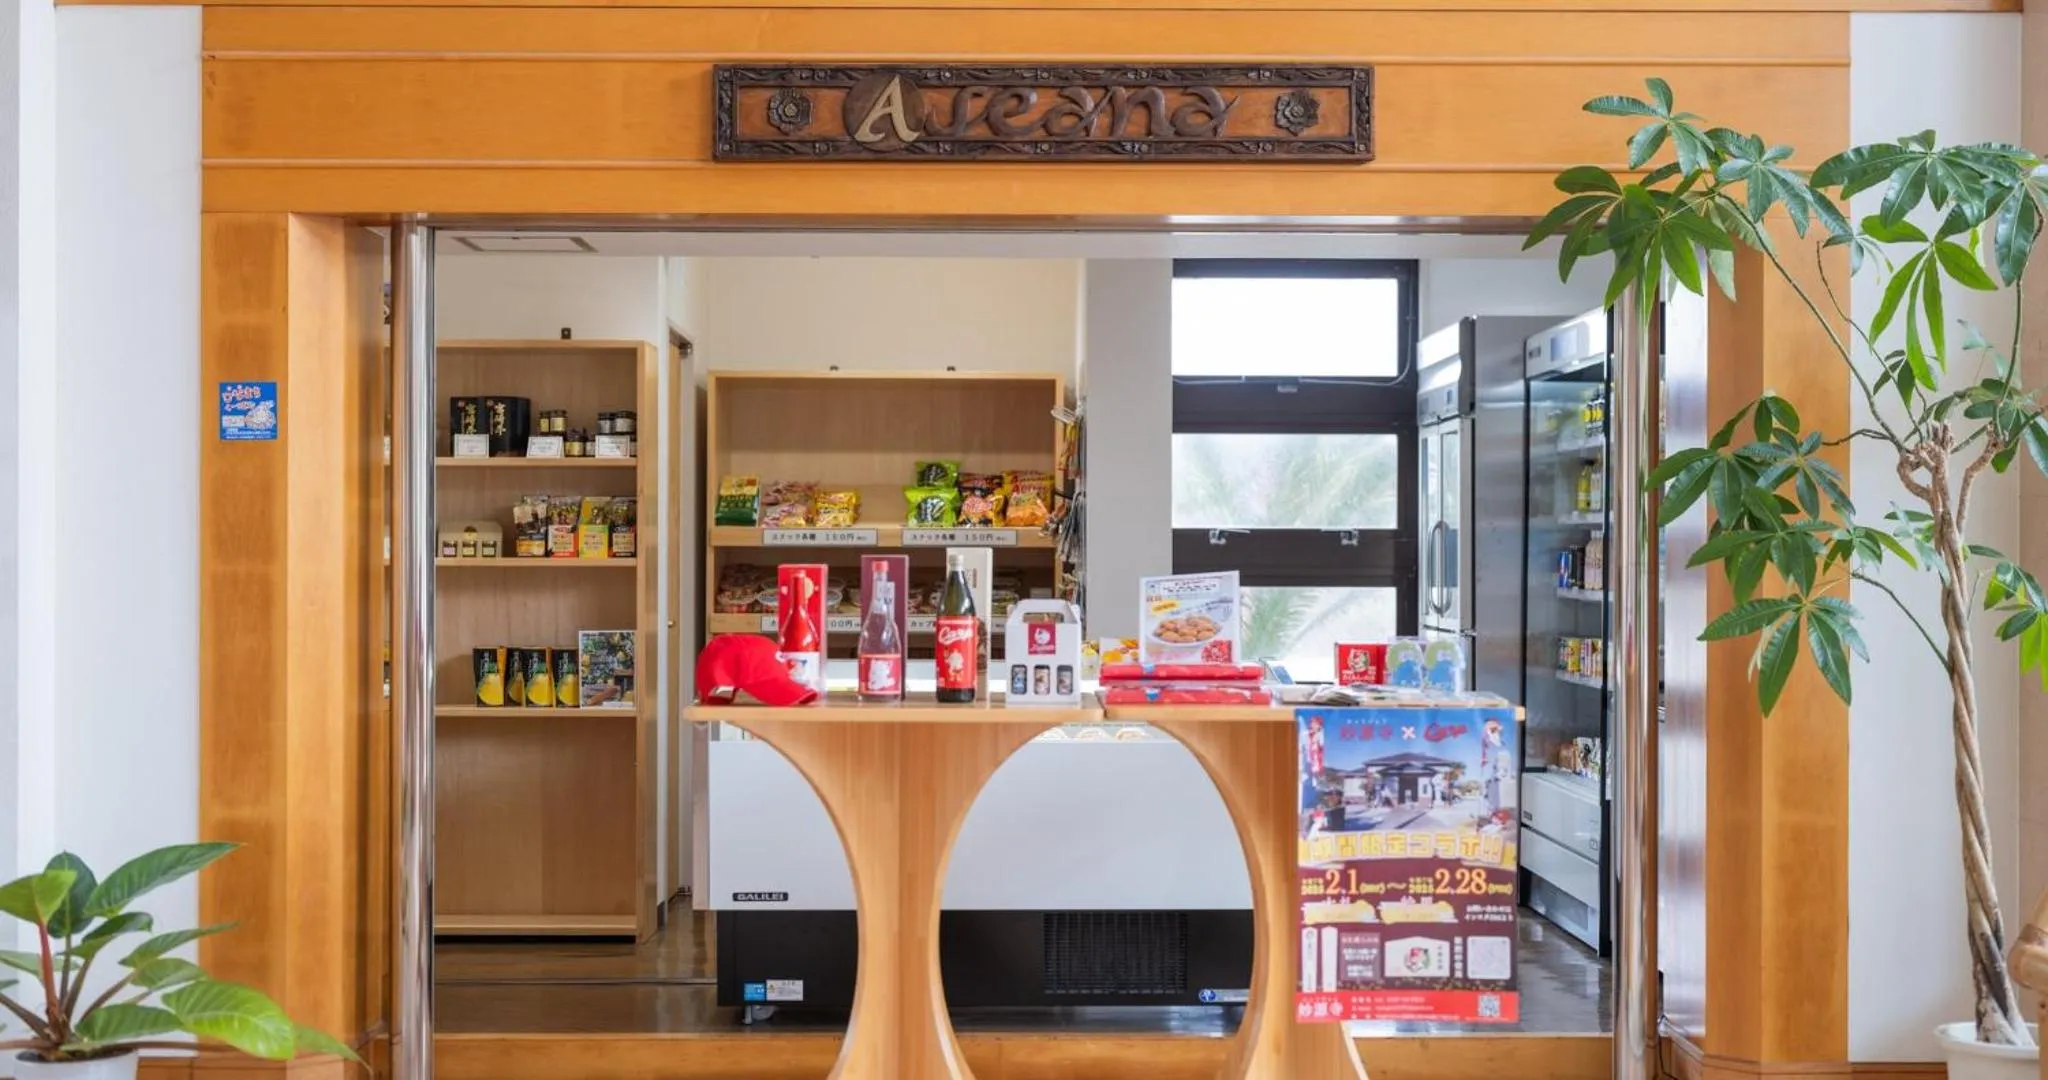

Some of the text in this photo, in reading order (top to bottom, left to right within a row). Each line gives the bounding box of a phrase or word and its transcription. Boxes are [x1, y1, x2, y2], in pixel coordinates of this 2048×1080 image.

[1424, 721, 1469, 742] Carp
[736, 892, 786, 902] GALILEI
[1297, 1001, 1344, 1018] 妙源寺
